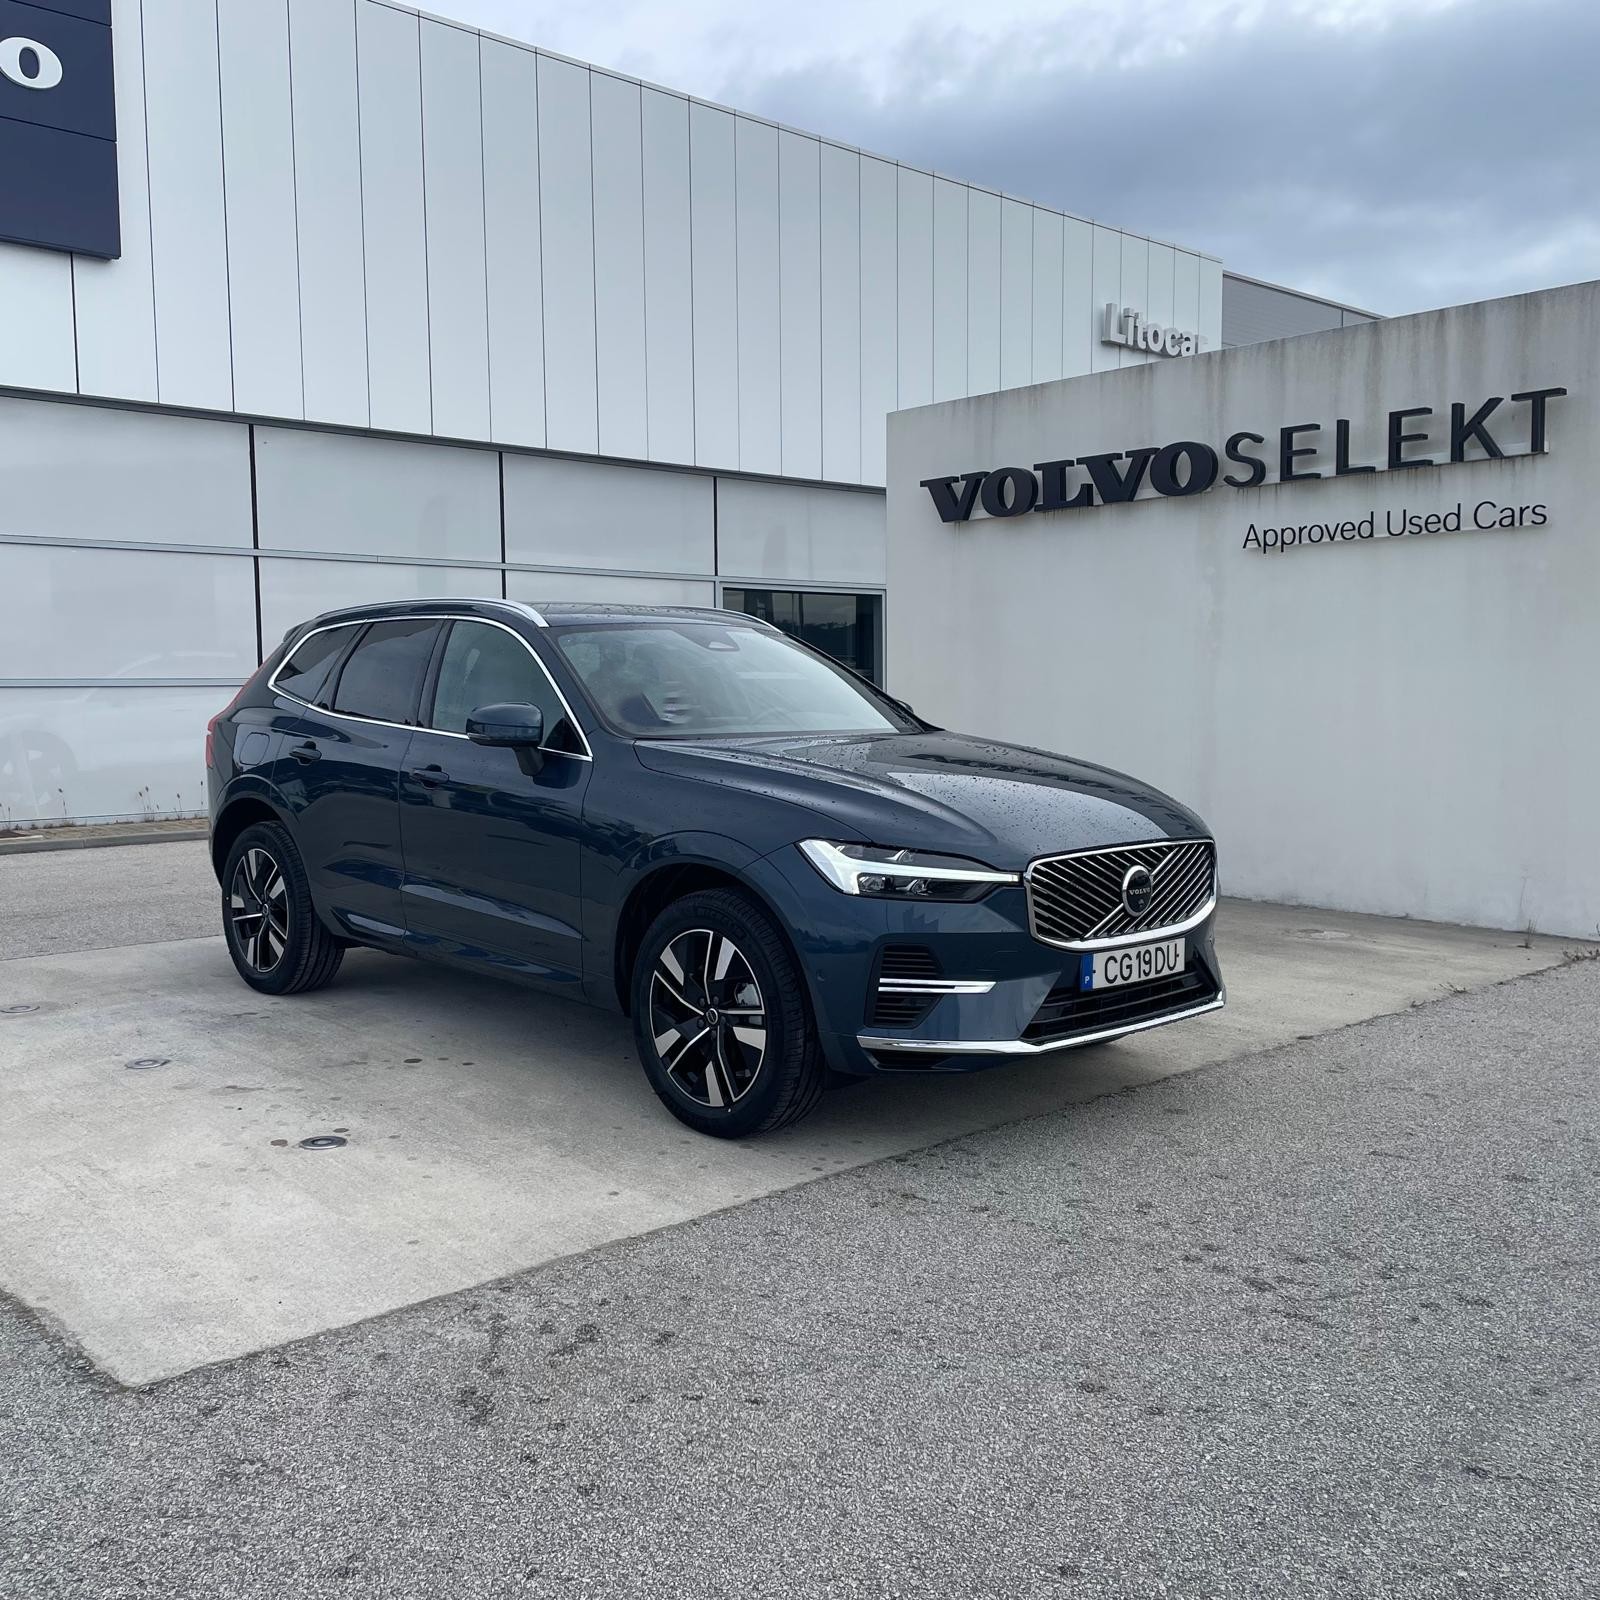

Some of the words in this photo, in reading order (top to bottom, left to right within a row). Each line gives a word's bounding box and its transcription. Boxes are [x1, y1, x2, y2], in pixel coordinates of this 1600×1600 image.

[1243, 511, 1374, 554] Approved
[1387, 503, 1461, 537] Used
[1473, 501, 1547, 530] Cars
